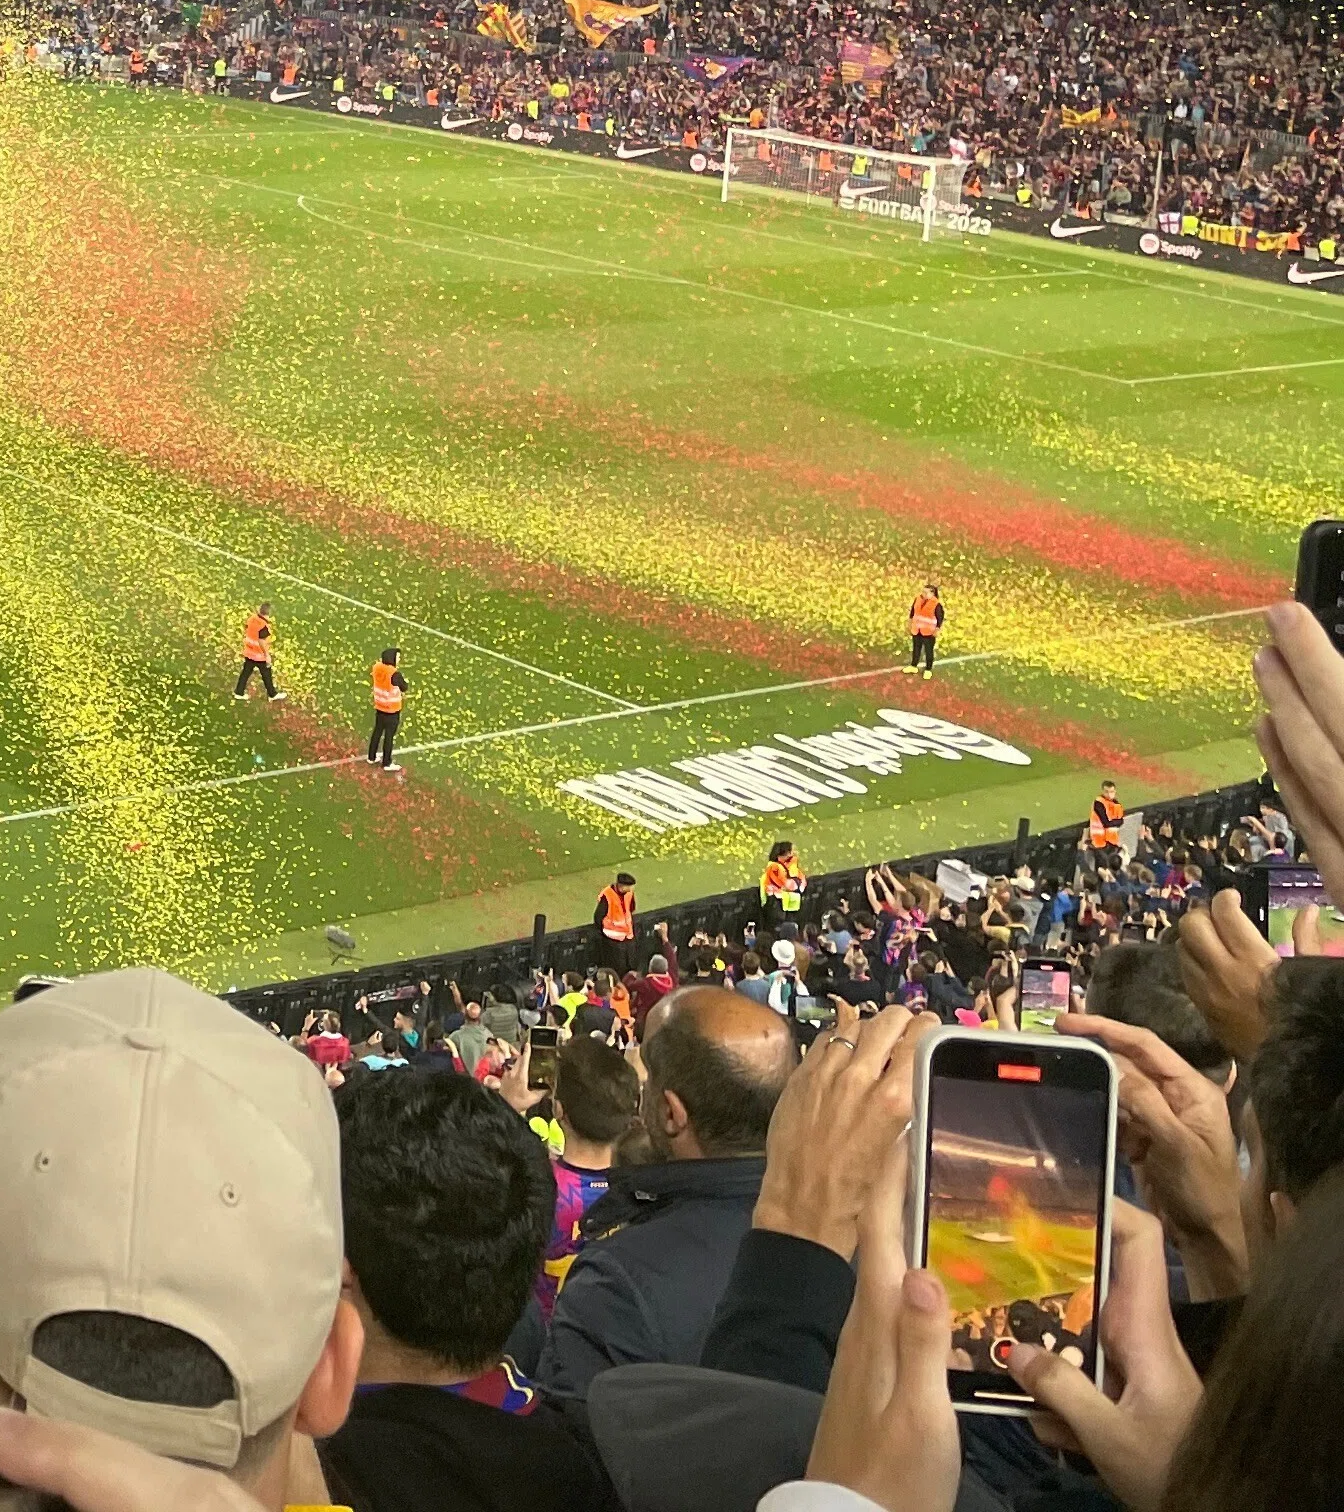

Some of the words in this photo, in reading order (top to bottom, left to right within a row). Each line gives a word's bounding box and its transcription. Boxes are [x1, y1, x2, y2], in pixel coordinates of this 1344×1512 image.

[947, 213, 992, 236] 2023
[1160, 240, 1203, 260] Spotify
[774, 720, 963, 776] Spotify
[555, 767, 748, 834] NOU
[669, 745, 869, 813] CAMP
